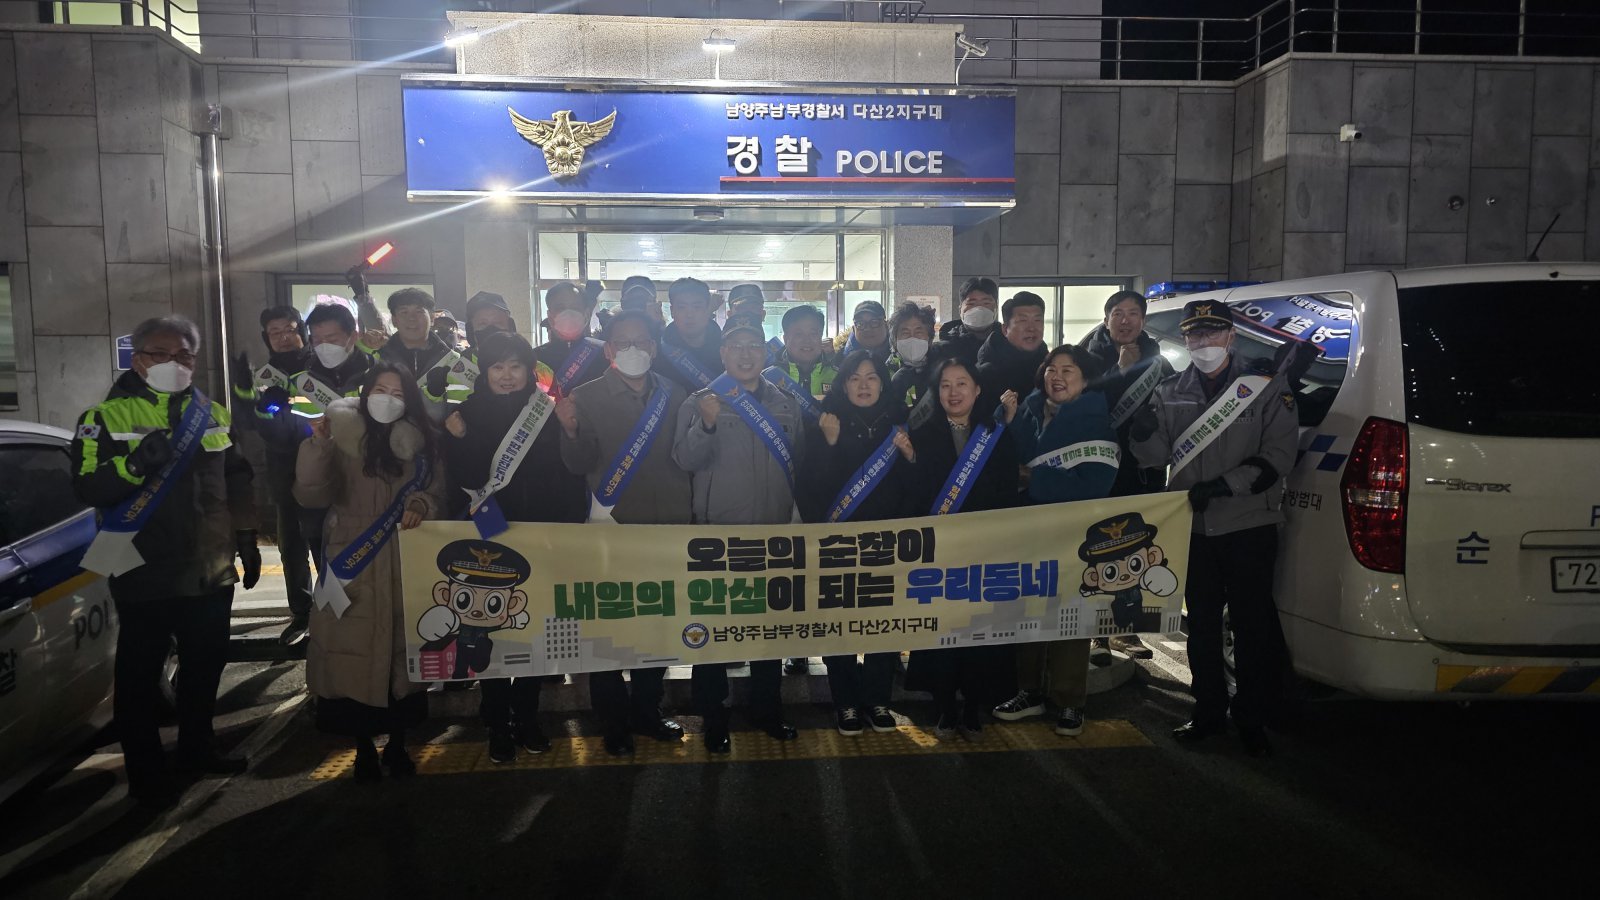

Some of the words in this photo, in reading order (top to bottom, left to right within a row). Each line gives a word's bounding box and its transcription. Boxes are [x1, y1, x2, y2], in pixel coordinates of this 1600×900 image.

[726, 103, 845, 120] 남양주남부경찰서
[854, 104, 943, 120] 다산2지구대
[837, 150, 943, 174] POLICE
[1218, 398, 1240, 417] 시민과
[522, 412, 540, 430] 만드는
[644, 414, 658, 432] 행복한
[741, 400, 761, 420] 안전하고
[759, 419, 776, 439] 행복한
[1206, 412, 1224, 430] 함께
[513, 429, 528, 443] 범죄
[1190, 424, 1212, 444] 만드는
[505, 441, 521, 455] 없는
[629, 431, 648, 456] 우리동네
[967, 442, 985, 462] 행복한
[1084, 446, 1098, 457] 함께
[1180, 439, 1195, 454] 범죄
[620, 454, 634, 469] 함께
[1062, 448, 1082, 462] 만드는
[1098, 446, 1115, 460] 시민과
[867, 458, 885, 477] 행복한
[955, 459, 974, 486] 우리동네
[848, 474, 870, 497] 우리동네
[947, 484, 960, 500] 함께
[1446, 478, 1512, 493] Starex
[839, 494, 852, 508] 함께
[1281, 490, 1322, 511] 방범대
[370, 528, 384, 544] 함께
[687, 536, 806, 572] 오늘의
[818, 527, 935, 569] 순찰이
[1456, 531, 1490, 564] 순
[1568, 562, 1598, 586] 72
[554, 580, 676, 620] 내일의
[688, 575, 806, 616] 안심이
[818, 572, 895, 609] 되는
[906, 560, 1058, 604] 우리동네
[712, 618, 842, 642] 남양주남부경찰서
[848, 616, 938, 636] 다산2지구대
